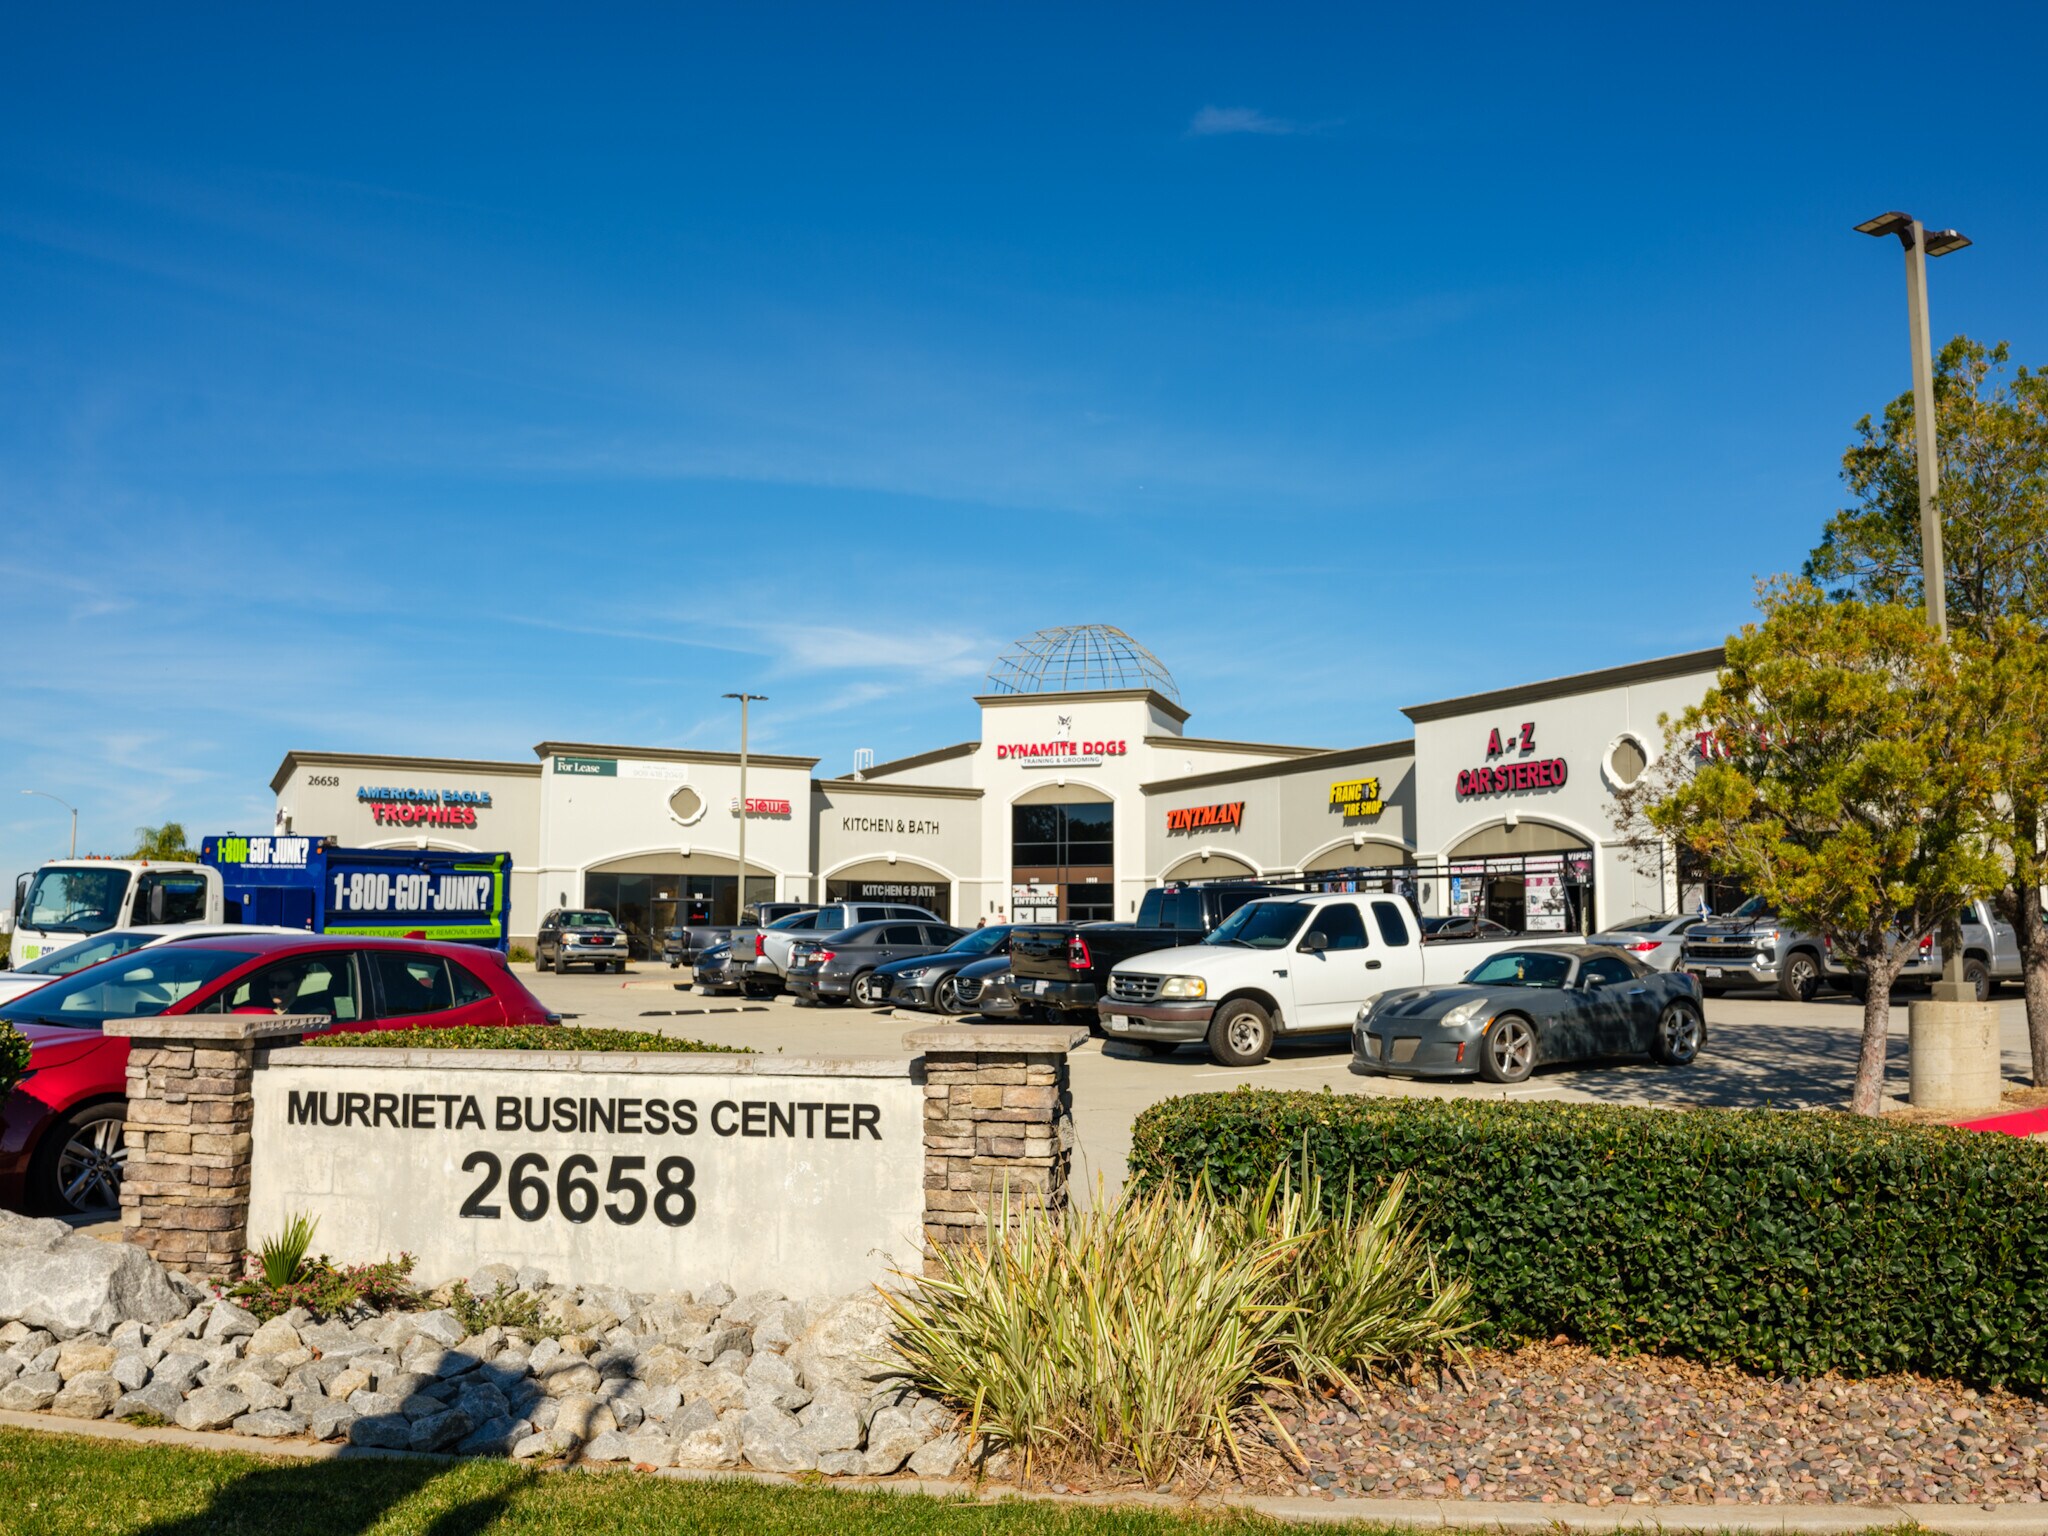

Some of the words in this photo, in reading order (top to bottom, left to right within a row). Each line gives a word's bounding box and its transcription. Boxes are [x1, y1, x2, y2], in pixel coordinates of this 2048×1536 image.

[997, 741, 1077, 758] DYNAMITE
[1083, 740, 1127, 755] DOGS
[557, 761, 573, 772] For
[574, 762, 601, 774] Lease
[308, 775, 340, 787] 26658
[1457, 767, 1492, 797] CAR
[1494, 758, 1568, 792] STEREO
[356, 786, 438, 801] AMERICAN
[441, 789, 491, 803] EAGLE
[370, 803, 476, 825] TROPHIES
[1166, 801, 1245, 831] TINTMAN
[1343, 802, 1361, 817] TIRE
[1361, 800, 1383, 816] SHOP
[842, 817, 894, 833] KITCHEN
[896, 819, 905, 833] &
[908, 820, 940, 835] BATH
[1567, 852, 1593, 861] VIPER
[333, 872, 491, 911] 1-800-GOT-JUNK?
[862, 884, 902, 897] KITCHEN
[903, 885, 911, 897] &
[910, 886, 936, 897] BATH
[1013, 897, 1057, 905] ENTRANCE
[436, 928, 467, 936] REMOVAL
[470, 928, 495, 936] SERVICE
[288, 1090, 485, 1130] MURRIETA
[496, 1096, 698, 1136] BUSINESS
[710, 1099, 882, 1141] CENTER
[459, 1150, 697, 1227] 26658
